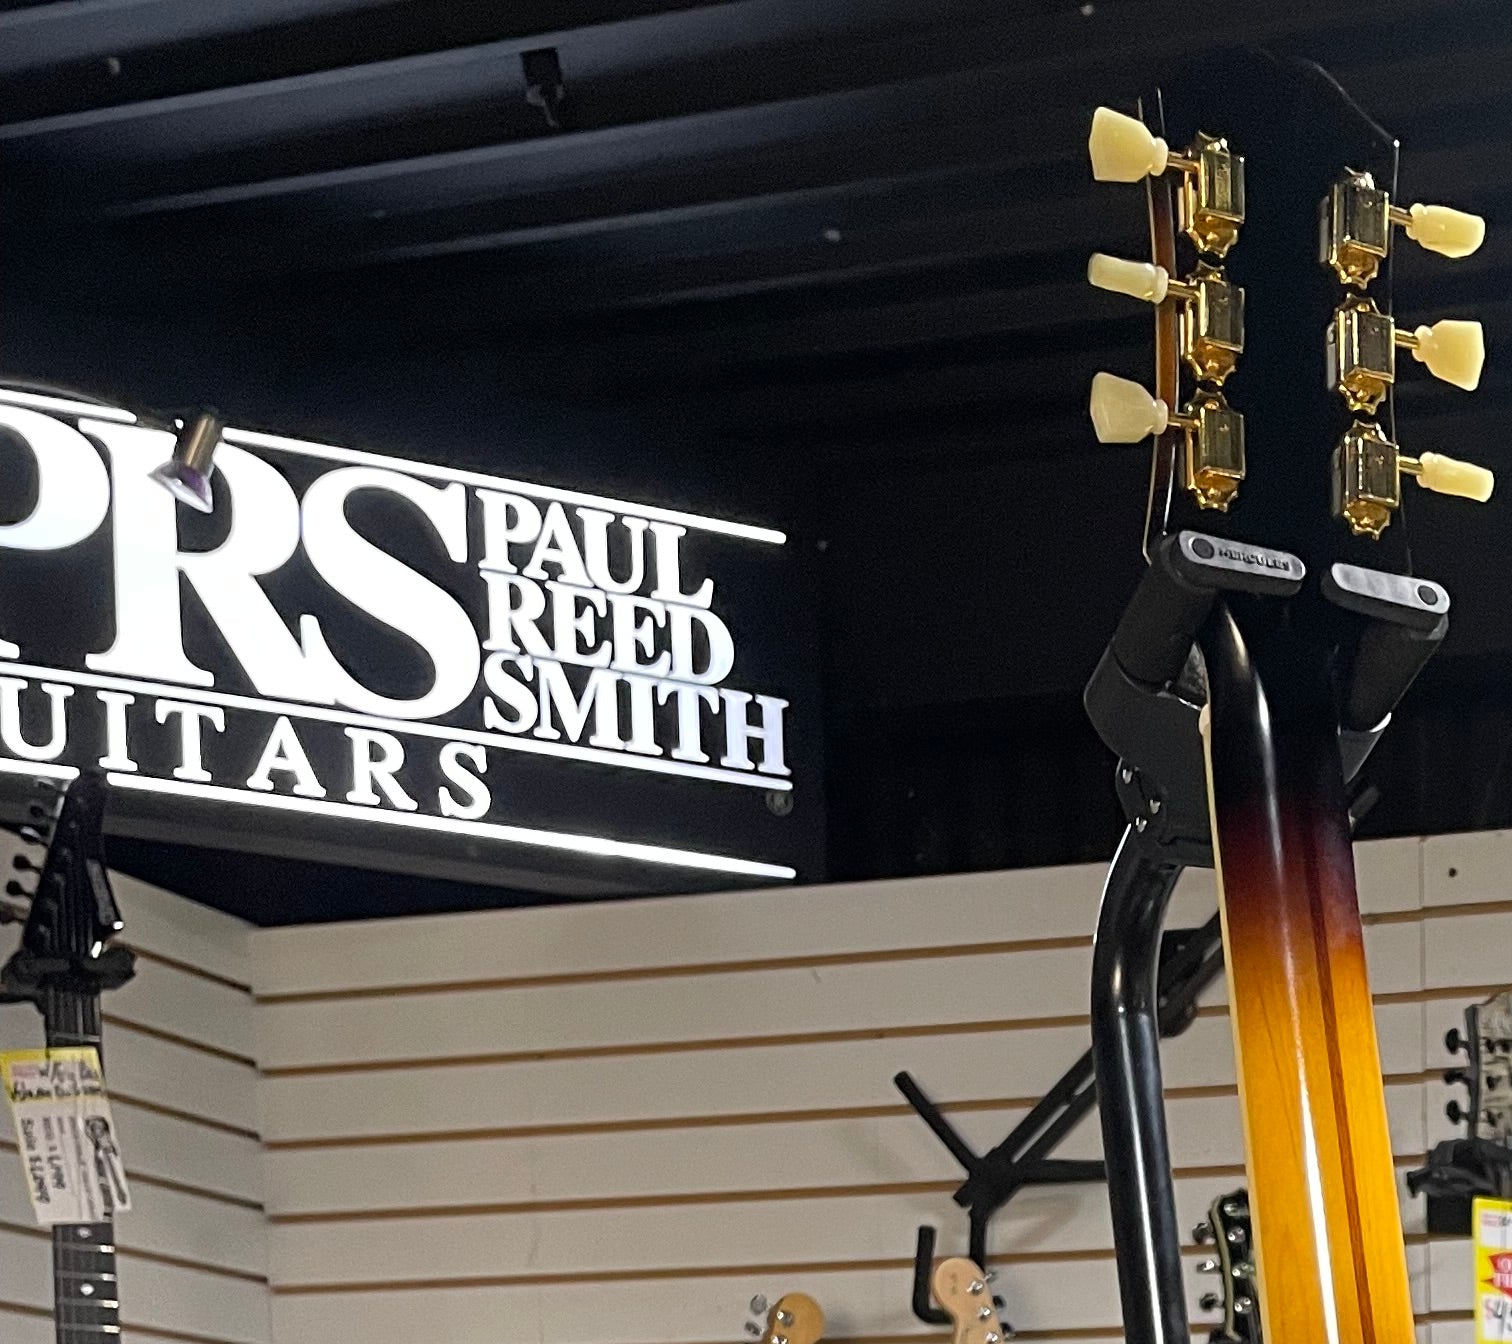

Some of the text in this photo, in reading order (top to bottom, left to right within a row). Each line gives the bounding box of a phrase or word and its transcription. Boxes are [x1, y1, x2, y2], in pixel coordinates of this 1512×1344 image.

[475, 488, 714, 610] PAUL
[479, 569, 735, 686] REED
[0, 678, 492, 820] UITARS
[483, 651, 793, 776] SMITH
